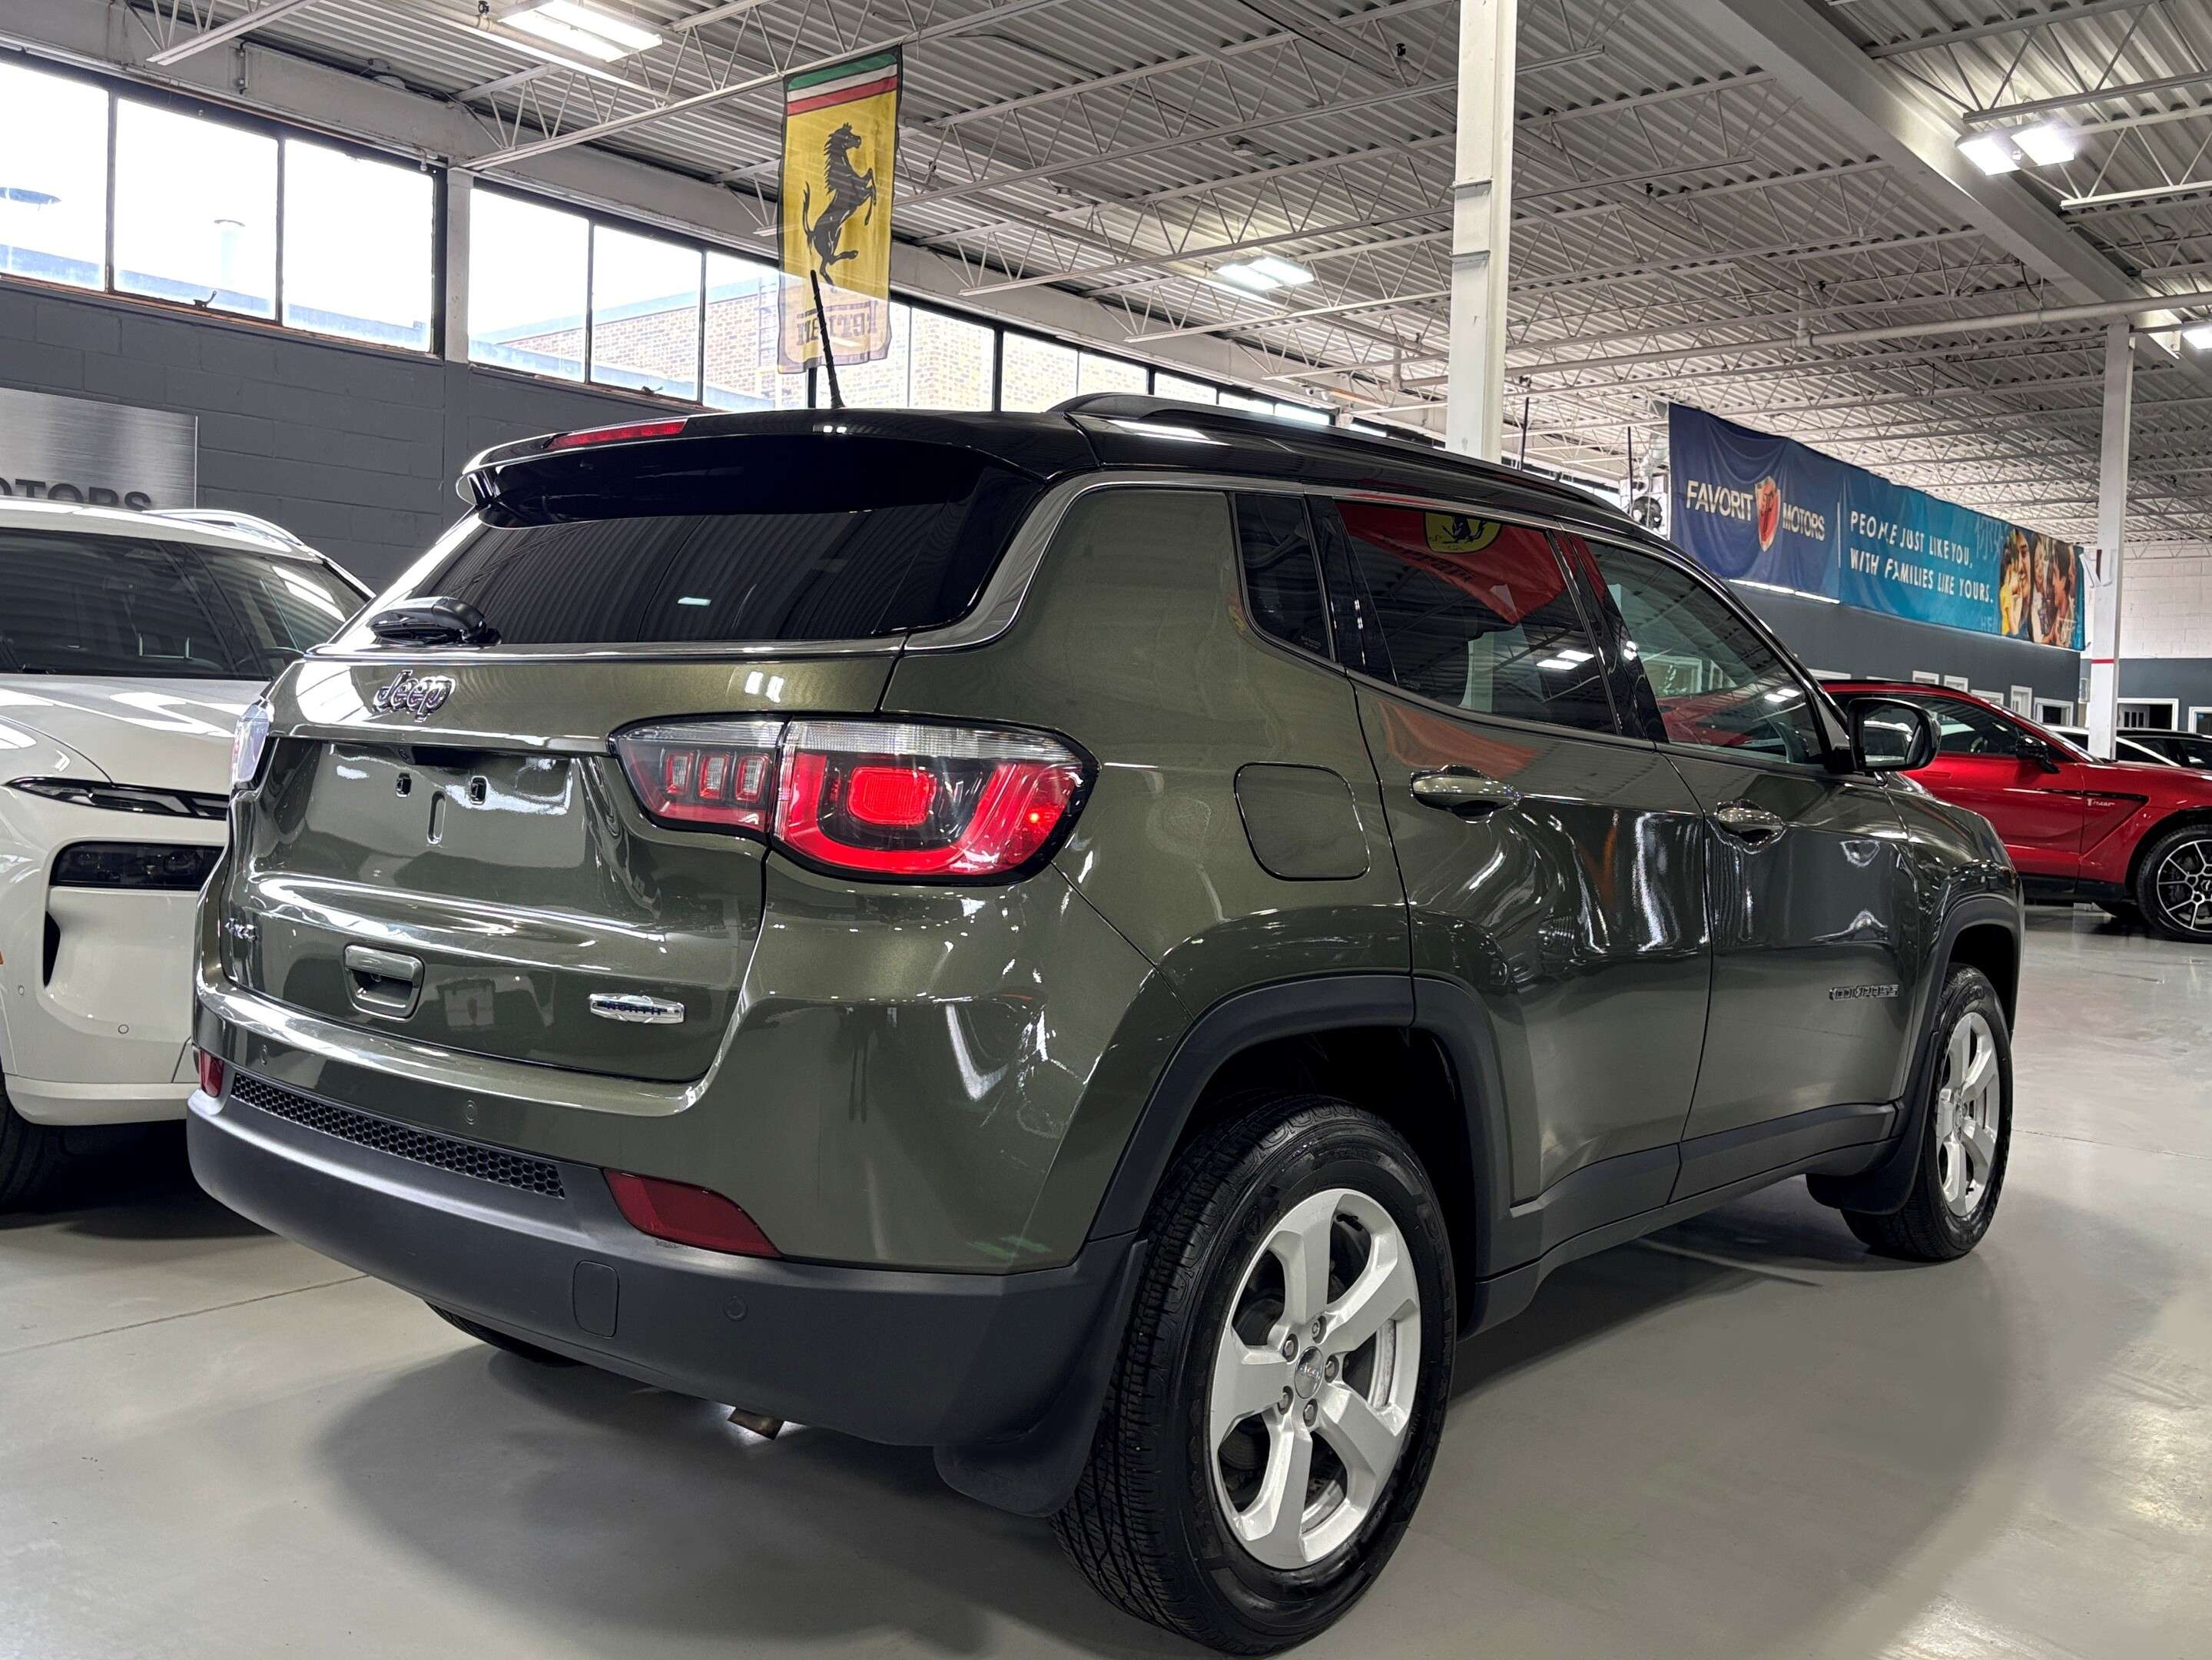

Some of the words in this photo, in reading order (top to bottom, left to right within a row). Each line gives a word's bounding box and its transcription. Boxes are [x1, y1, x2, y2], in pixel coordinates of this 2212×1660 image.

[1686, 480, 1753, 522] FAVORIT
[1783, 502, 1826, 542] MOTORS
[1850, 547, 1879, 576] WITH
[1937, 572, 1955, 596] LIKE
[1959, 577, 1994, 603] YOURS.
[1900, 528, 1925, 553] JUST
[1929, 535, 1949, 559] LIKE
[1951, 541, 1973, 569] YOU,
[373, 669, 456, 723] Jeep
[1829, 984, 1899, 1001] COMPASS
